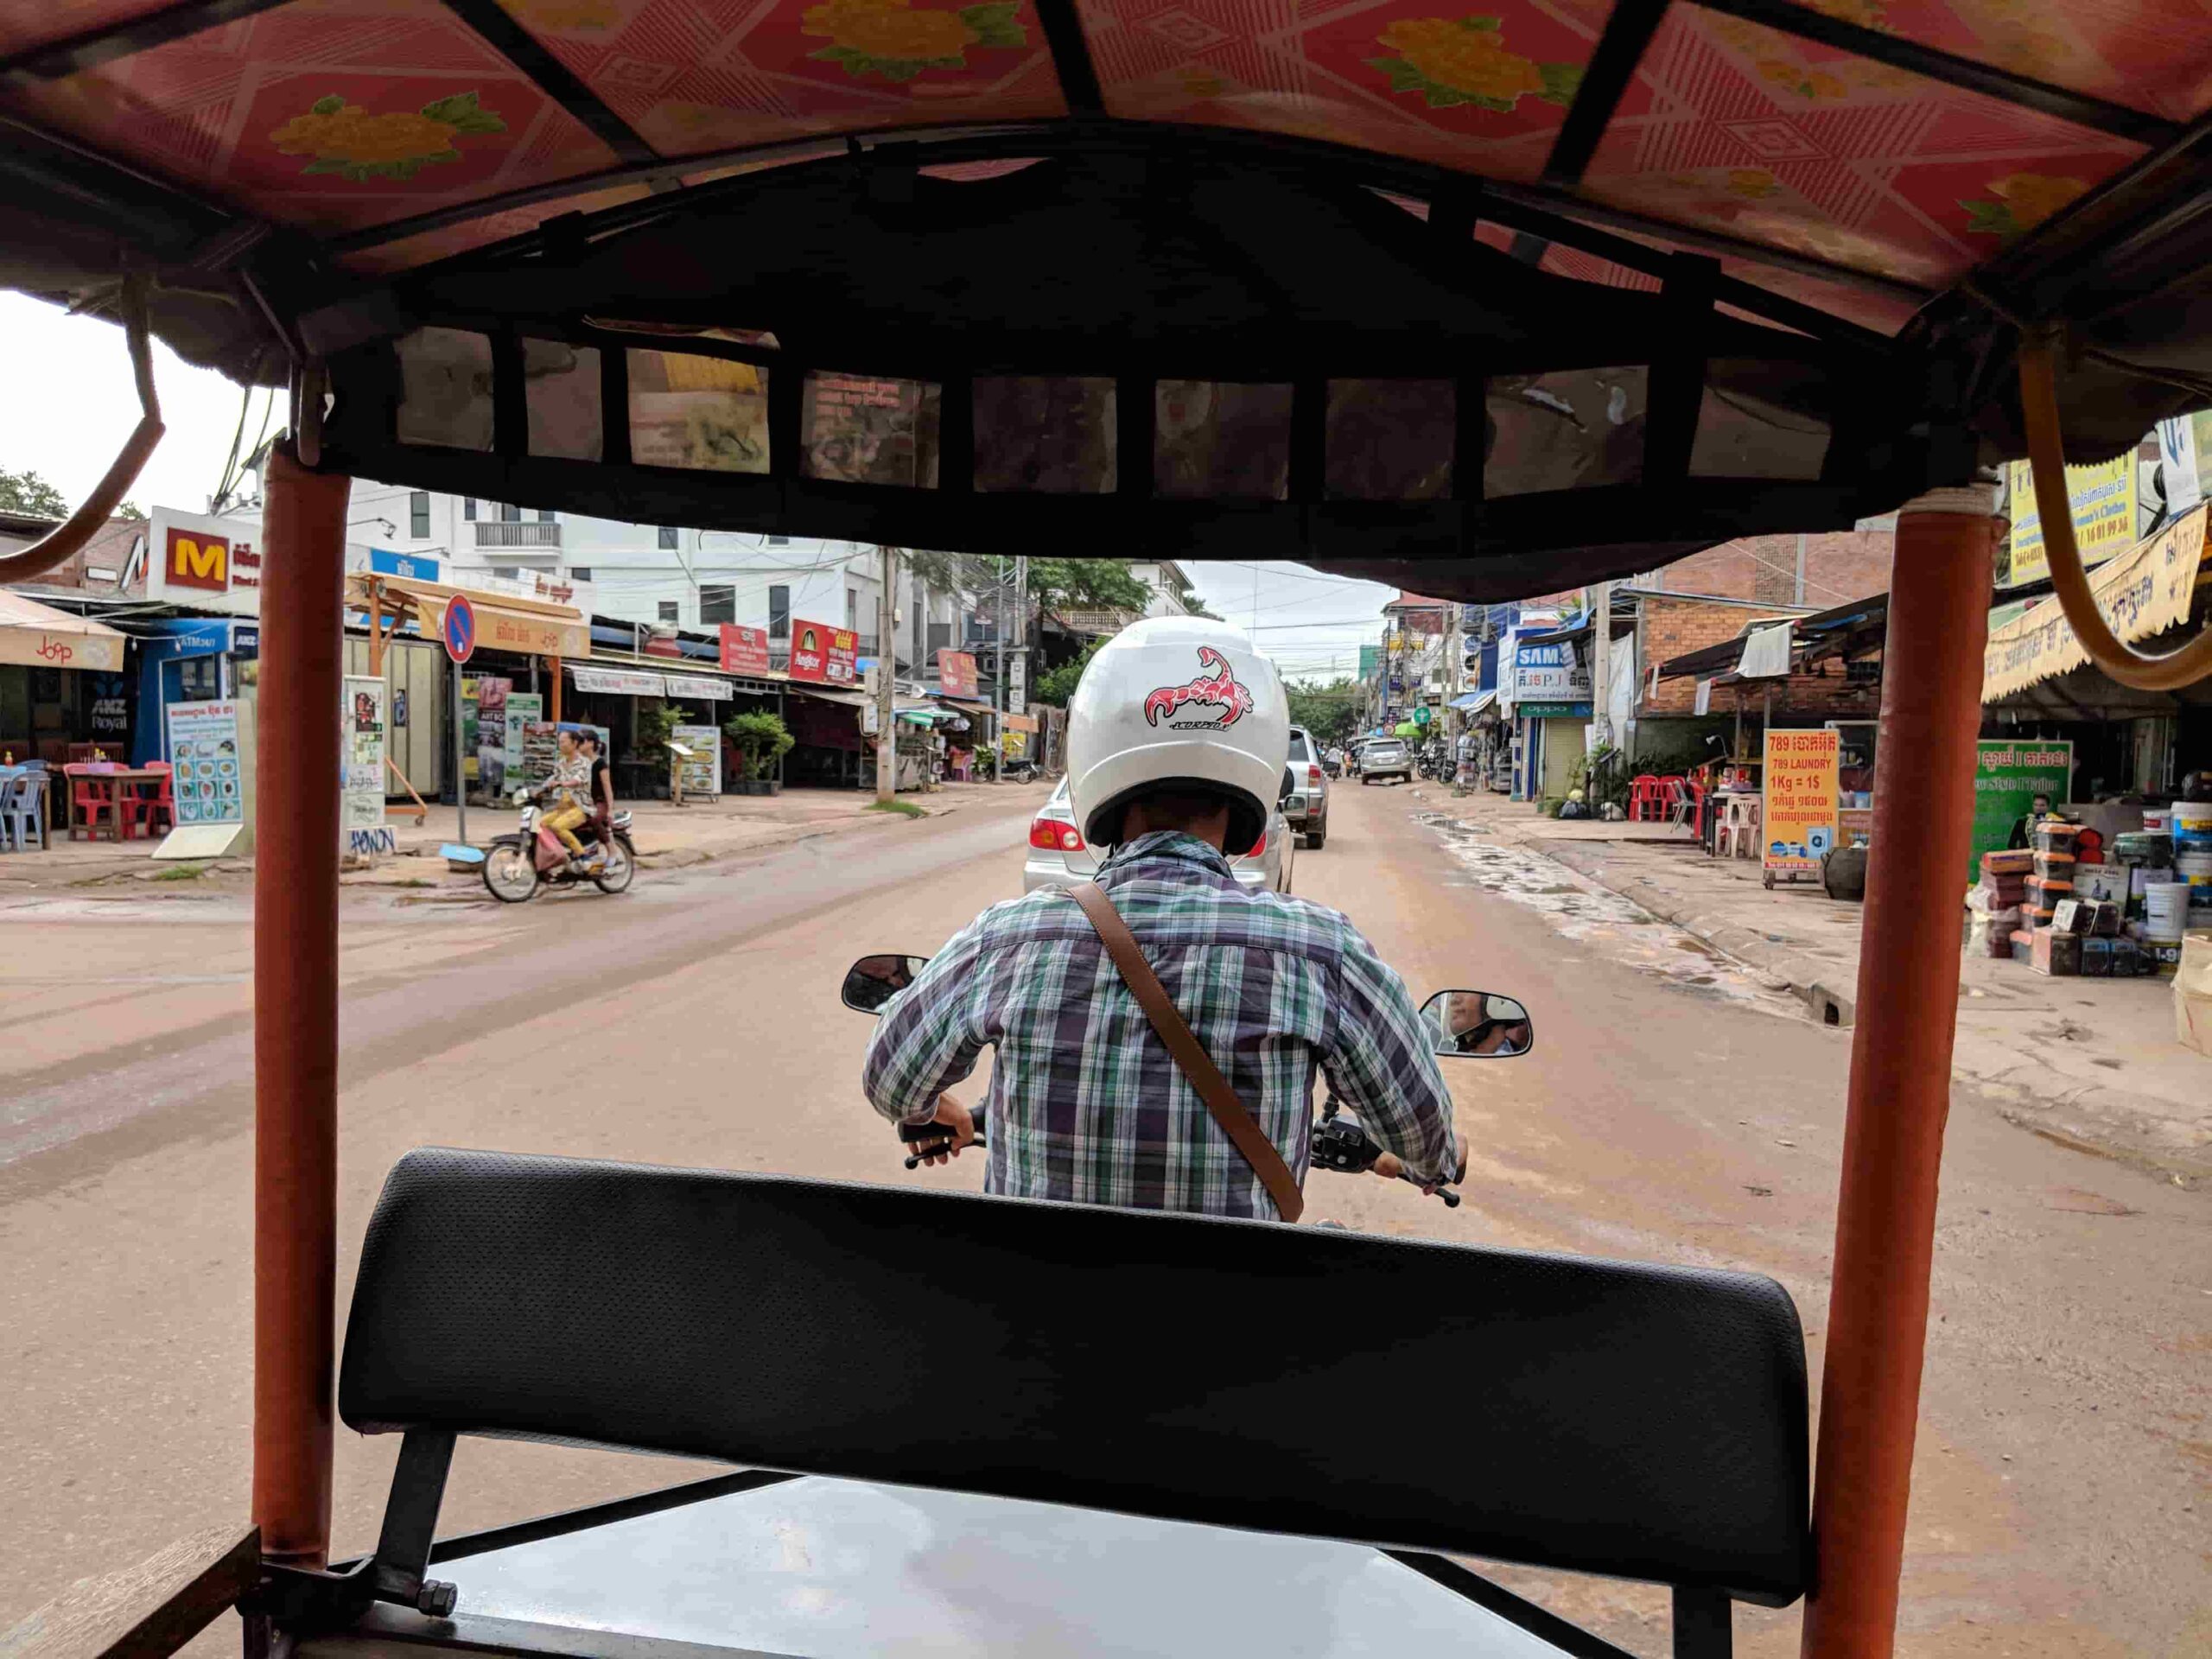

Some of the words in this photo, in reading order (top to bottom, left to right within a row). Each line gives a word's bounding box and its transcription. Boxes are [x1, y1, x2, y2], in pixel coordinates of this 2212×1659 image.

[175, 537, 226, 582] M
[1519, 647, 1563, 664] SAM
[480, 712, 494, 721] ART
[92, 715, 128, 734] Royal
[1769, 736, 1789, 751] 789
[1773, 759, 1789, 769] 789
[1790, 759, 1832, 770] LAUNDRY
[1770, 775, 1793, 791] 1Kg
[1989, 778, 2017, 791] Style
